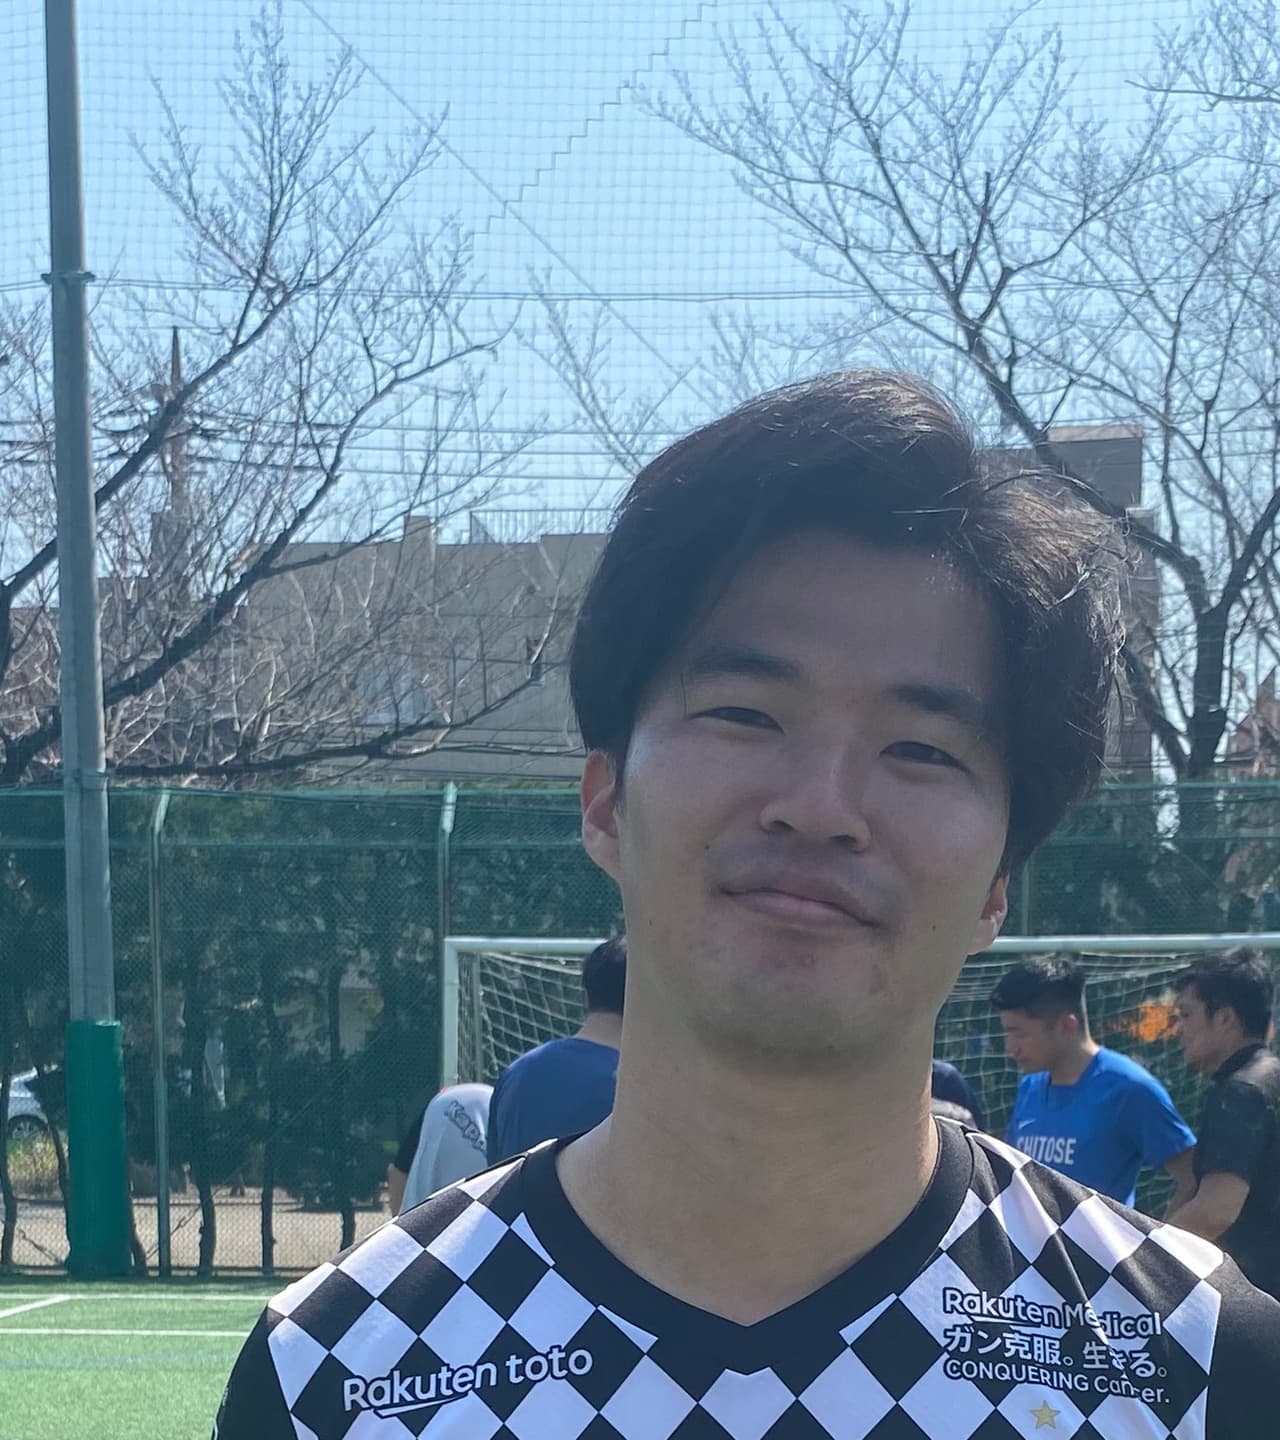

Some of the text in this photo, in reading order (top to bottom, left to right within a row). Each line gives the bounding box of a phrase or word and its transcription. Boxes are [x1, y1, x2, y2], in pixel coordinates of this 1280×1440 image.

[942, 1287, 1163, 1337] Rakuten Medical
[342, 1345, 594, 1412] Rakuten toto
[944, 1359, 1171, 1404] CONQUERING Caner.
